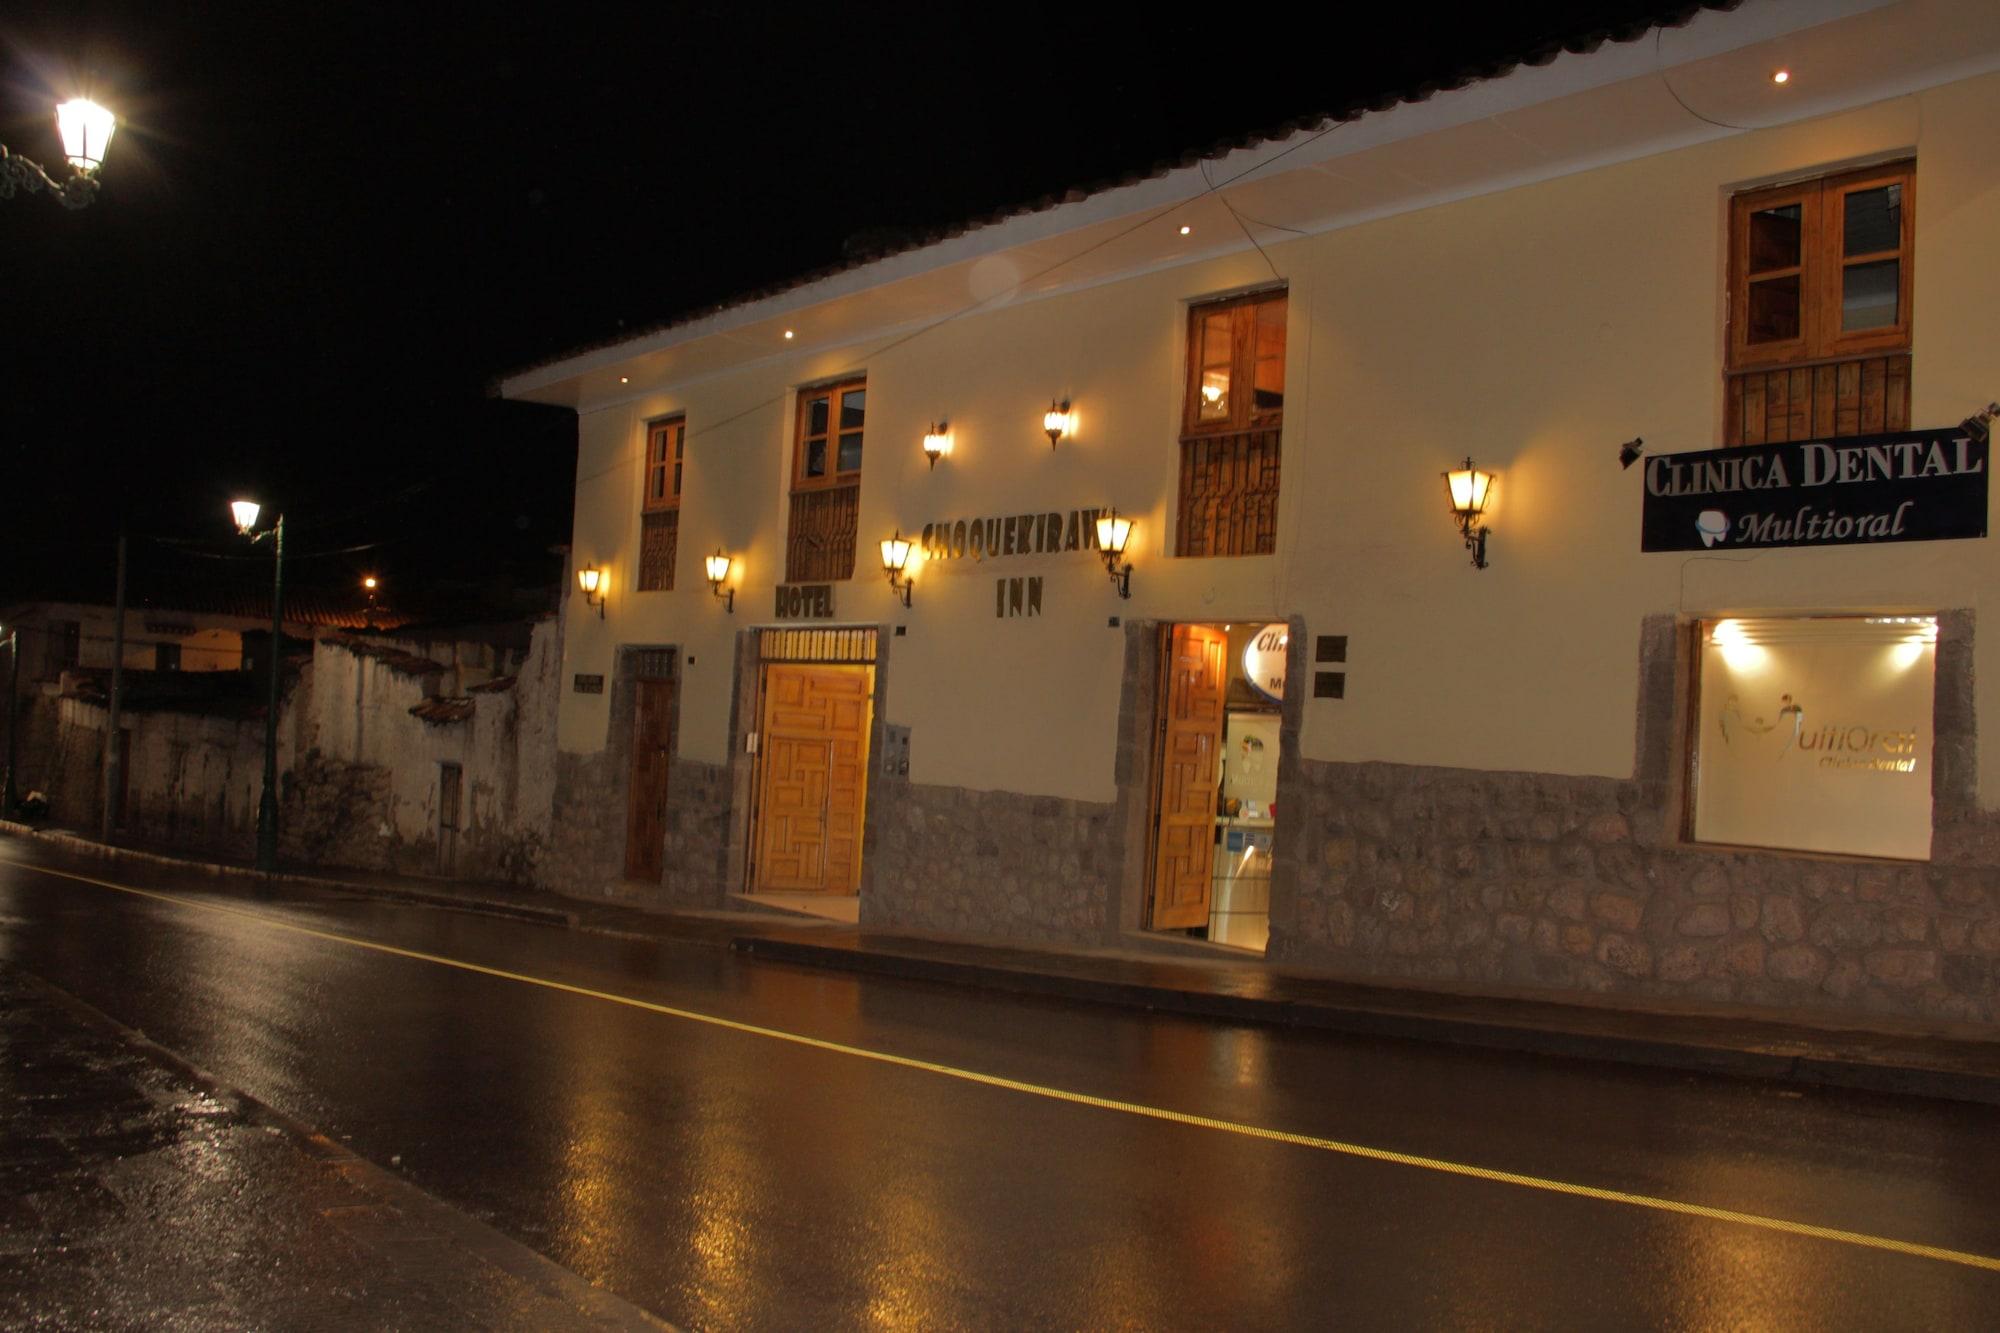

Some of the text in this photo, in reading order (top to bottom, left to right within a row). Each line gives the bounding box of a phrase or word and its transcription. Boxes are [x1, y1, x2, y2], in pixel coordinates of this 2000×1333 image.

[1646, 438, 1983, 497] CLINICA DENTAL
[1735, 501, 1914, 543] Multioral
[775, 585, 834, 618] HOTEL
[996, 576, 1043, 618] INN
